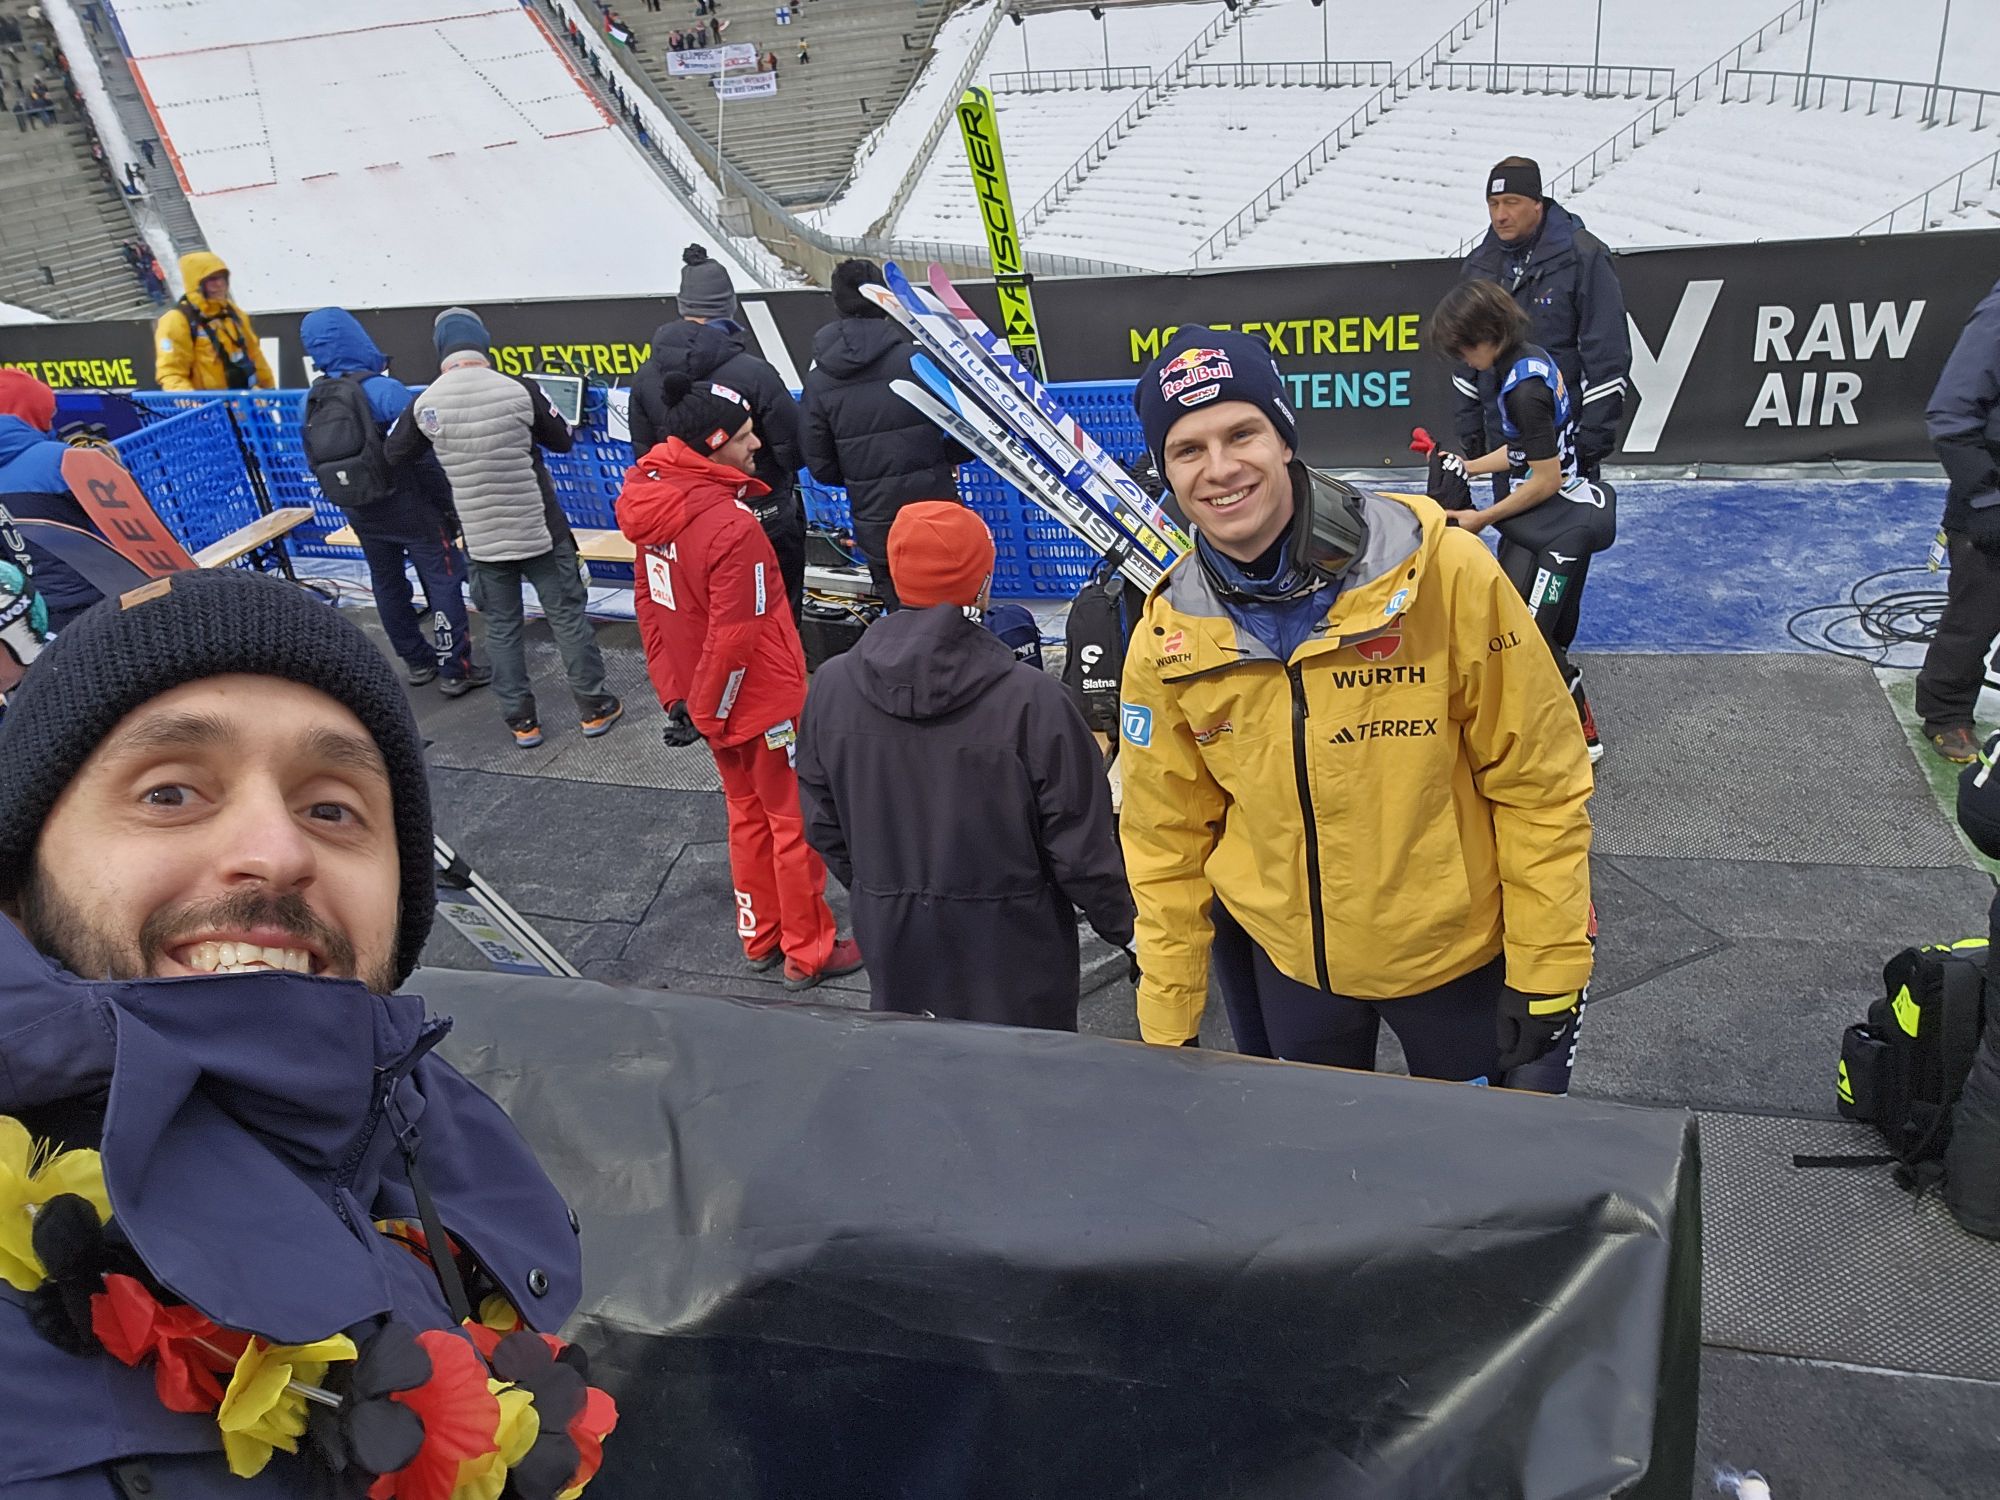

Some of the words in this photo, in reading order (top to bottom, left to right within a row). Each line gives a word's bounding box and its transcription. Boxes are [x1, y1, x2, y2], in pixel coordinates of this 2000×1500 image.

[1754, 301, 1926, 362] RAW
[42, 359, 137, 388] EXTREME
[1162, 369, 1195, 402] Red
[1195, 362, 1233, 384] Bull
[949, 339, 1071, 465] fluege.de
[1745, 372, 1863, 427] AIR
[988, 420, 1116, 544] Slatnar
[1487, 630, 1521, 660] OLL
[1332, 666, 1425, 689] WÜRTH
[1357, 718, 1438, 741] TERREX
